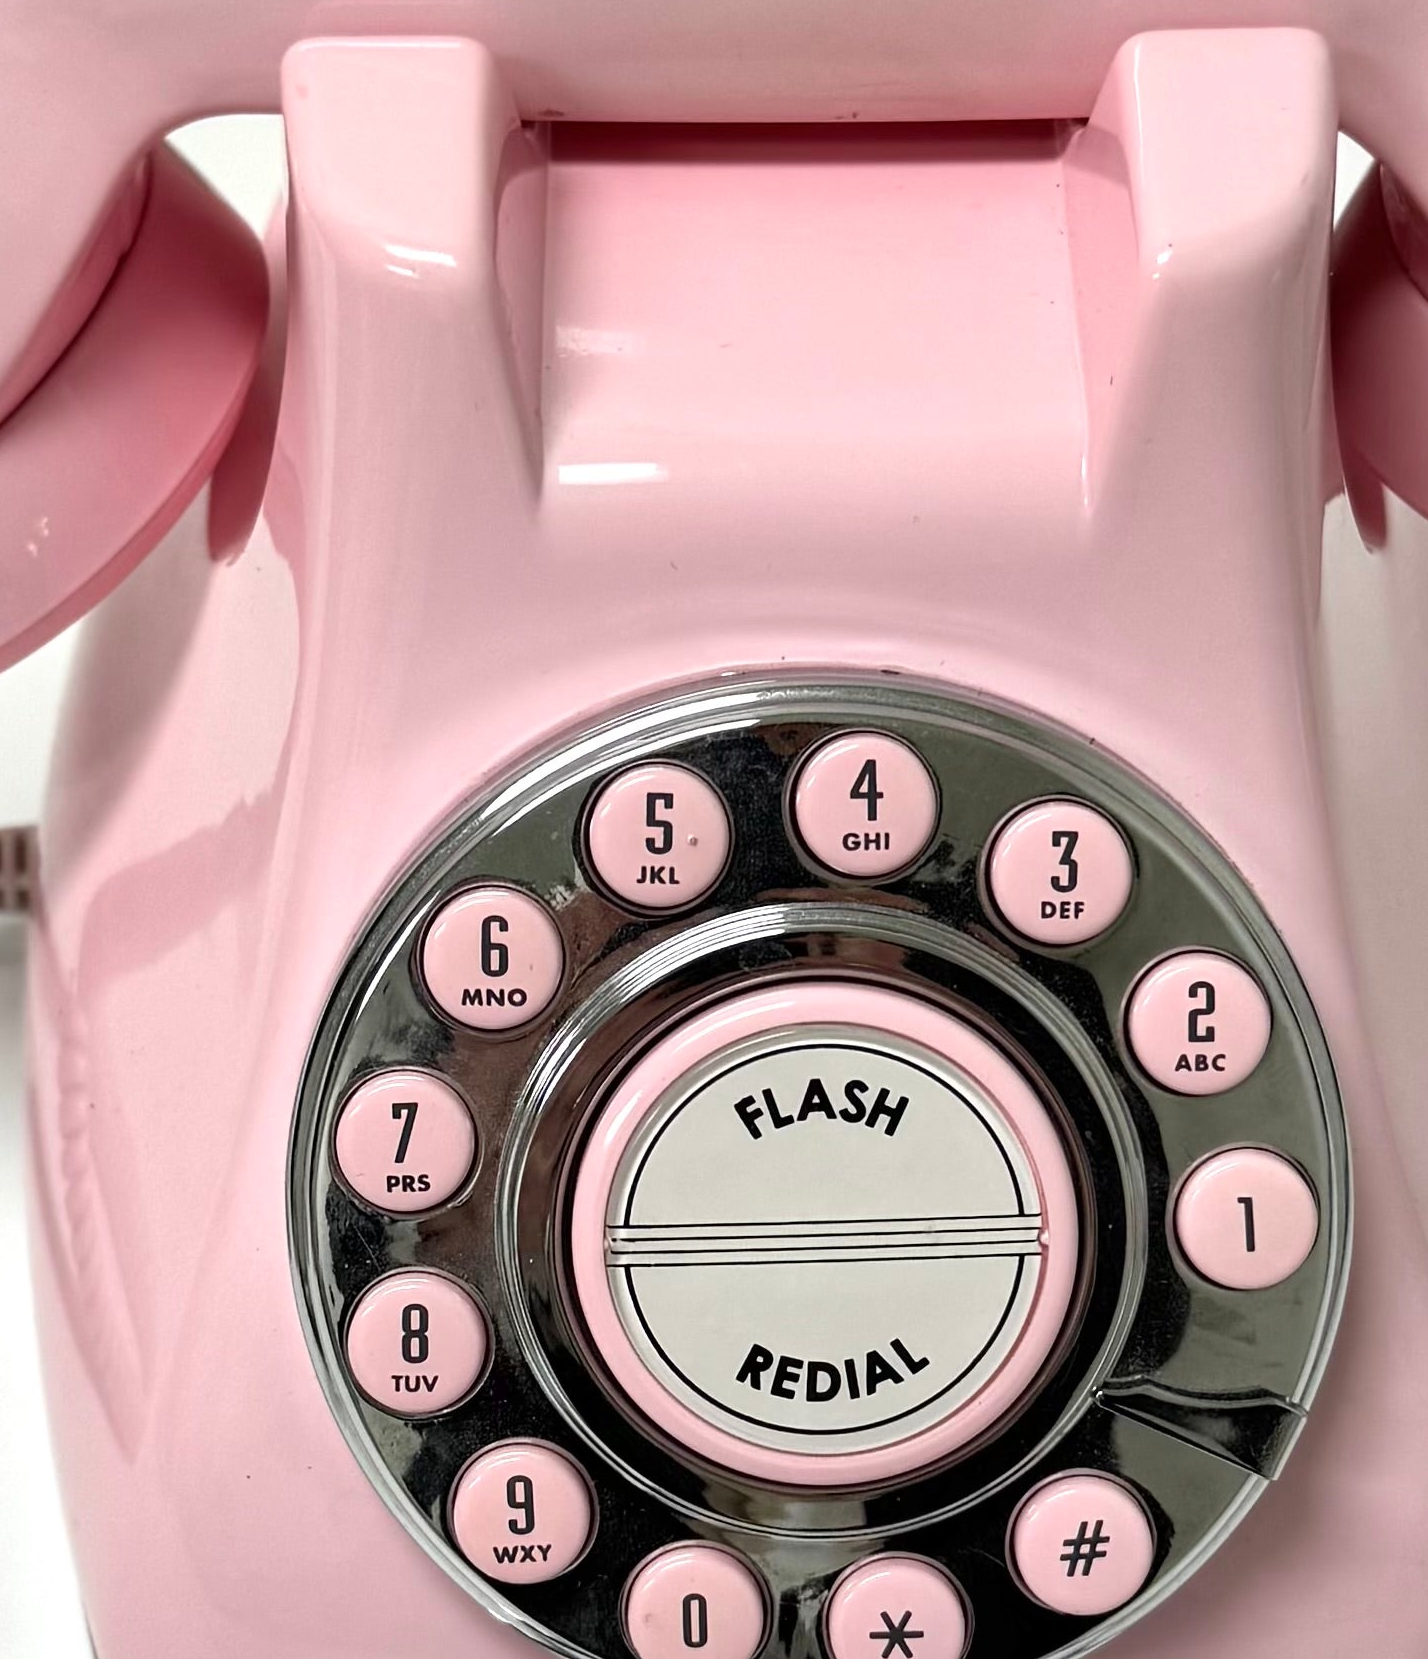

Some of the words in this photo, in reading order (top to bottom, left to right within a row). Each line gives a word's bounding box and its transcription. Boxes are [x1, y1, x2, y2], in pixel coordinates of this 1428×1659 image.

[849, 759, 884, 822] 4
[645, 792, 674, 855] 5
[842, 832, 890, 852] GHI
[636, 865, 681, 885] JKL
[1050, 830, 1079, 893] 3
[1040, 900, 1085, 920] DEF
[480, 914, 509, 978] 6
[461, 988, 528, 1007] MNO
[1187, 980, 1216, 1043] 2
[1174, 1053, 1226, 1072] ABC
[391, 1102, 419, 1164] 7
[733, 1078, 910, 1140] FLASH
[386, 1173, 431, 1193] PRS
[1237, 1196, 1256, 1253] 1
[401, 1303, 429, 1364] 8
[391, 1374, 439, 1393] TUV
[735, 1338, 930, 1403] REDIAL
[506, 1474, 535, 1536] 9
[492, 1544, 552, 1564] WXY
[1059, 1519, 1111, 1578] #
[682, 1593, 708, 1649] 0
